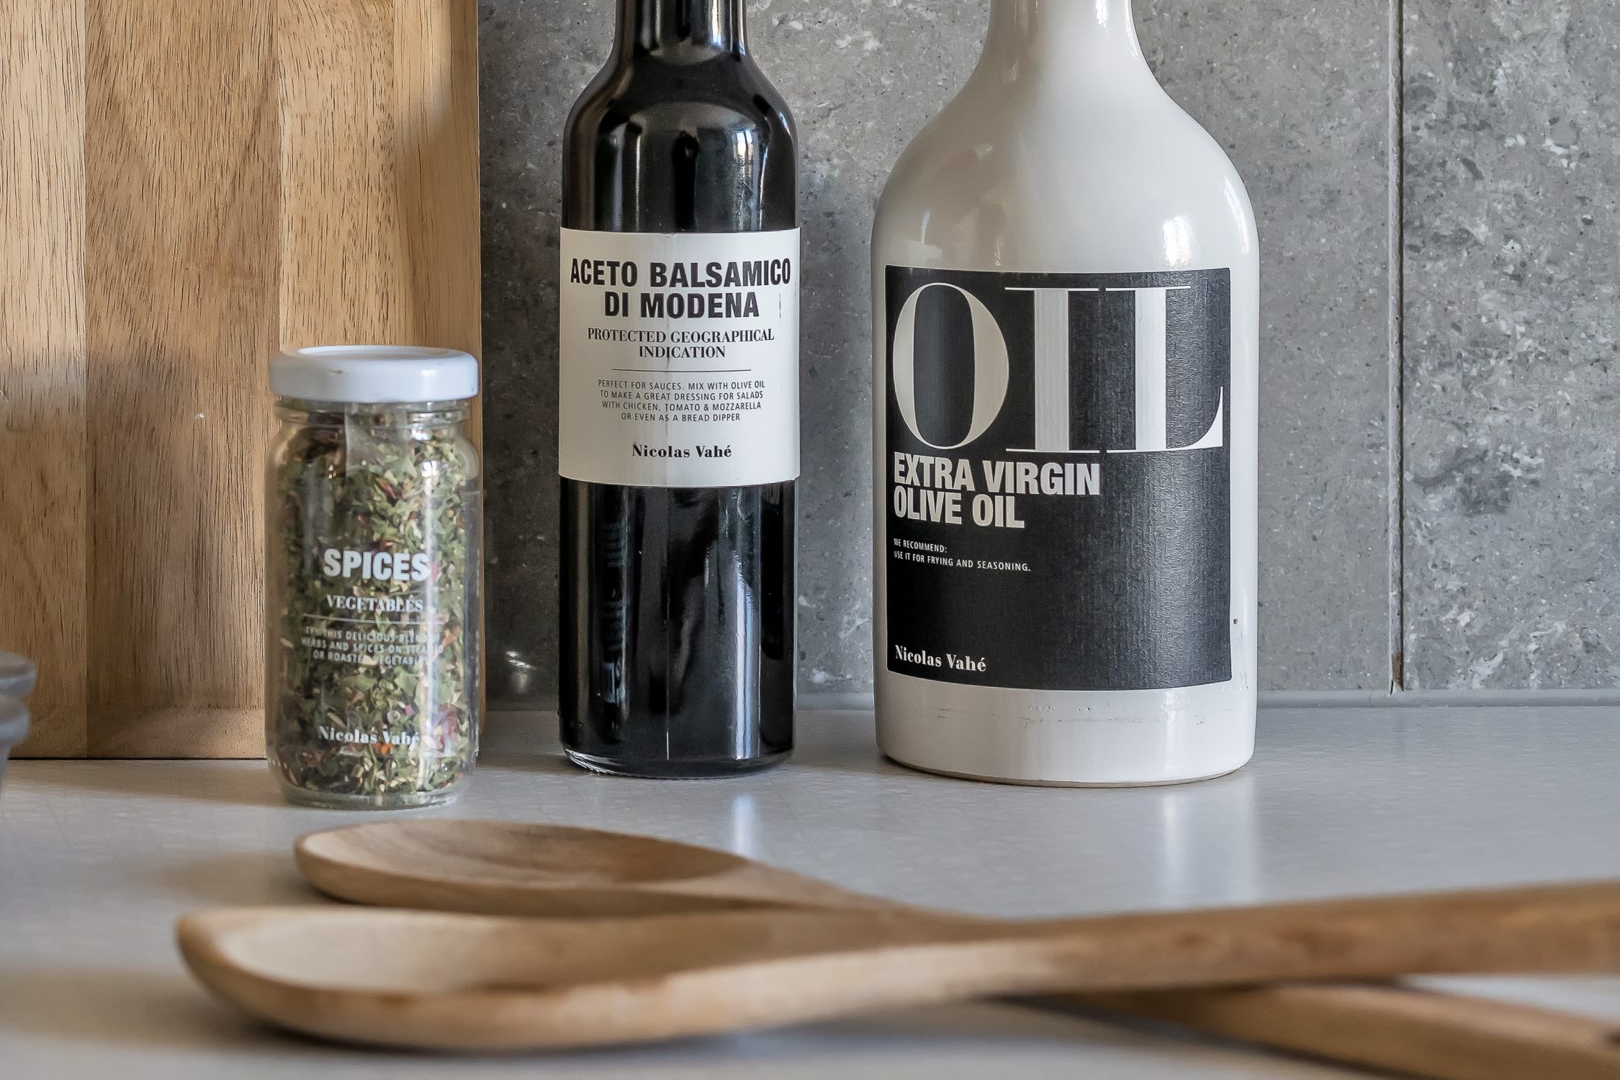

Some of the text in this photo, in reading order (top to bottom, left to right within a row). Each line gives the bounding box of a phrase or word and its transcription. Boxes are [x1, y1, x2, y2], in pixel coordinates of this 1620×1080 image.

[570, 258, 791, 288] ACETO BALSAMICO
[604, 291, 760, 319] DI MODENA
[587, 327, 775, 343] PROTECTED GEOGRAPHICAL
[638, 345, 726, 359] INDICATION
[892, 282, 1223, 453] OIL
[597, 379, 629, 389] PERFECT
[630, 381, 647, 389] FOR
[688, 382, 705, 390] MIX
[707, 381, 729, 390] WITH
[730, 381, 752, 390] OLIVE
[754, 380, 766, 389] OIL
[600, 390, 764, 401] TO MAKE A GREAT DRESSING FOR SALADS
[602, 401, 762, 412] WITH CHICKEN, TOMATO & MOZZARELLA
[621, 412, 741, 422] OR EVEN AS A BREAD DIPPER
[632, 443, 732, 458] Nicolas Vahé
[893, 451, 1100, 496] EXTRA VIRGIN
[893, 485, 1025, 529] OLIVE OIL
[893, 537, 948, 554] WE RECOMMEND:
[323, 548, 430, 582] SPICES
[893, 550, 1032, 572] USE IT FOR FRYING AND SEASONING.
[326, 593, 424, 613] VEGETABLES
[345, 630, 396, 643] DELICIOUS
[313, 649, 325, 660] OR
[327, 651, 370, 664] ROASTE
[329, 641, 349, 651] AND
[352, 642, 386, 654] SPICES
[388, 644, 403, 655] ON
[895, 644, 987, 672] Nicolas Vahé
[318, 725, 420, 745] Nicolas Vahé
